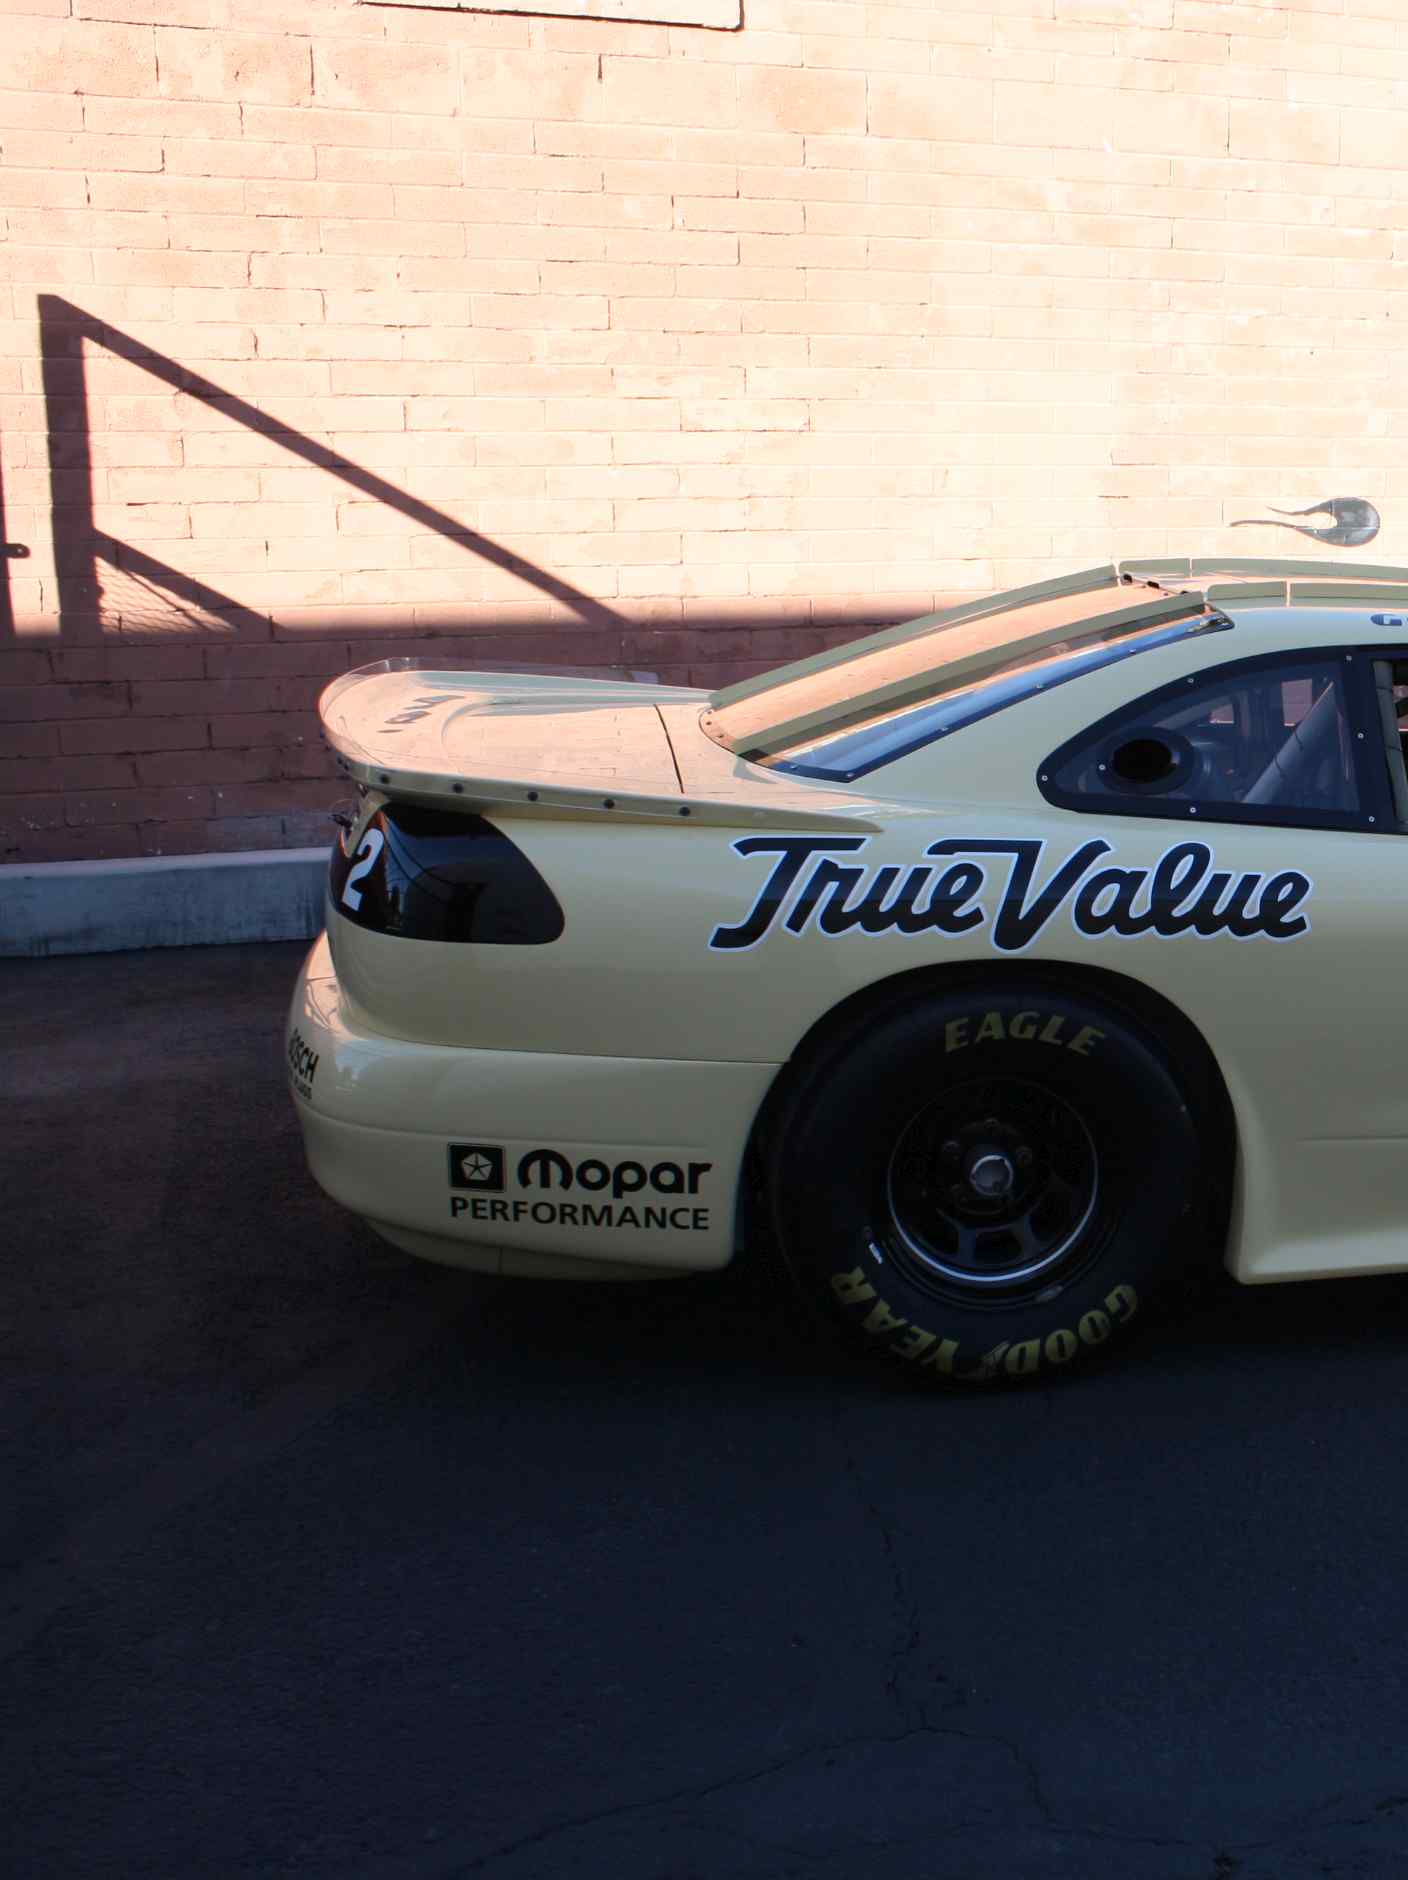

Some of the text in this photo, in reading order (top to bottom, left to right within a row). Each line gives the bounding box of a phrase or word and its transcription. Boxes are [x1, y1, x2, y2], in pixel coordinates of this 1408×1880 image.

[341, 828, 385, 911] 2
[709, 835, 1313, 952] True Value
[944, 1010, 1106, 1056] EAGLE
[516, 1148, 713, 1199] Mopar
[450, 1196, 710, 1231] PERFORMANCE
[831, 1265, 1139, 1376] GOODYEAR
